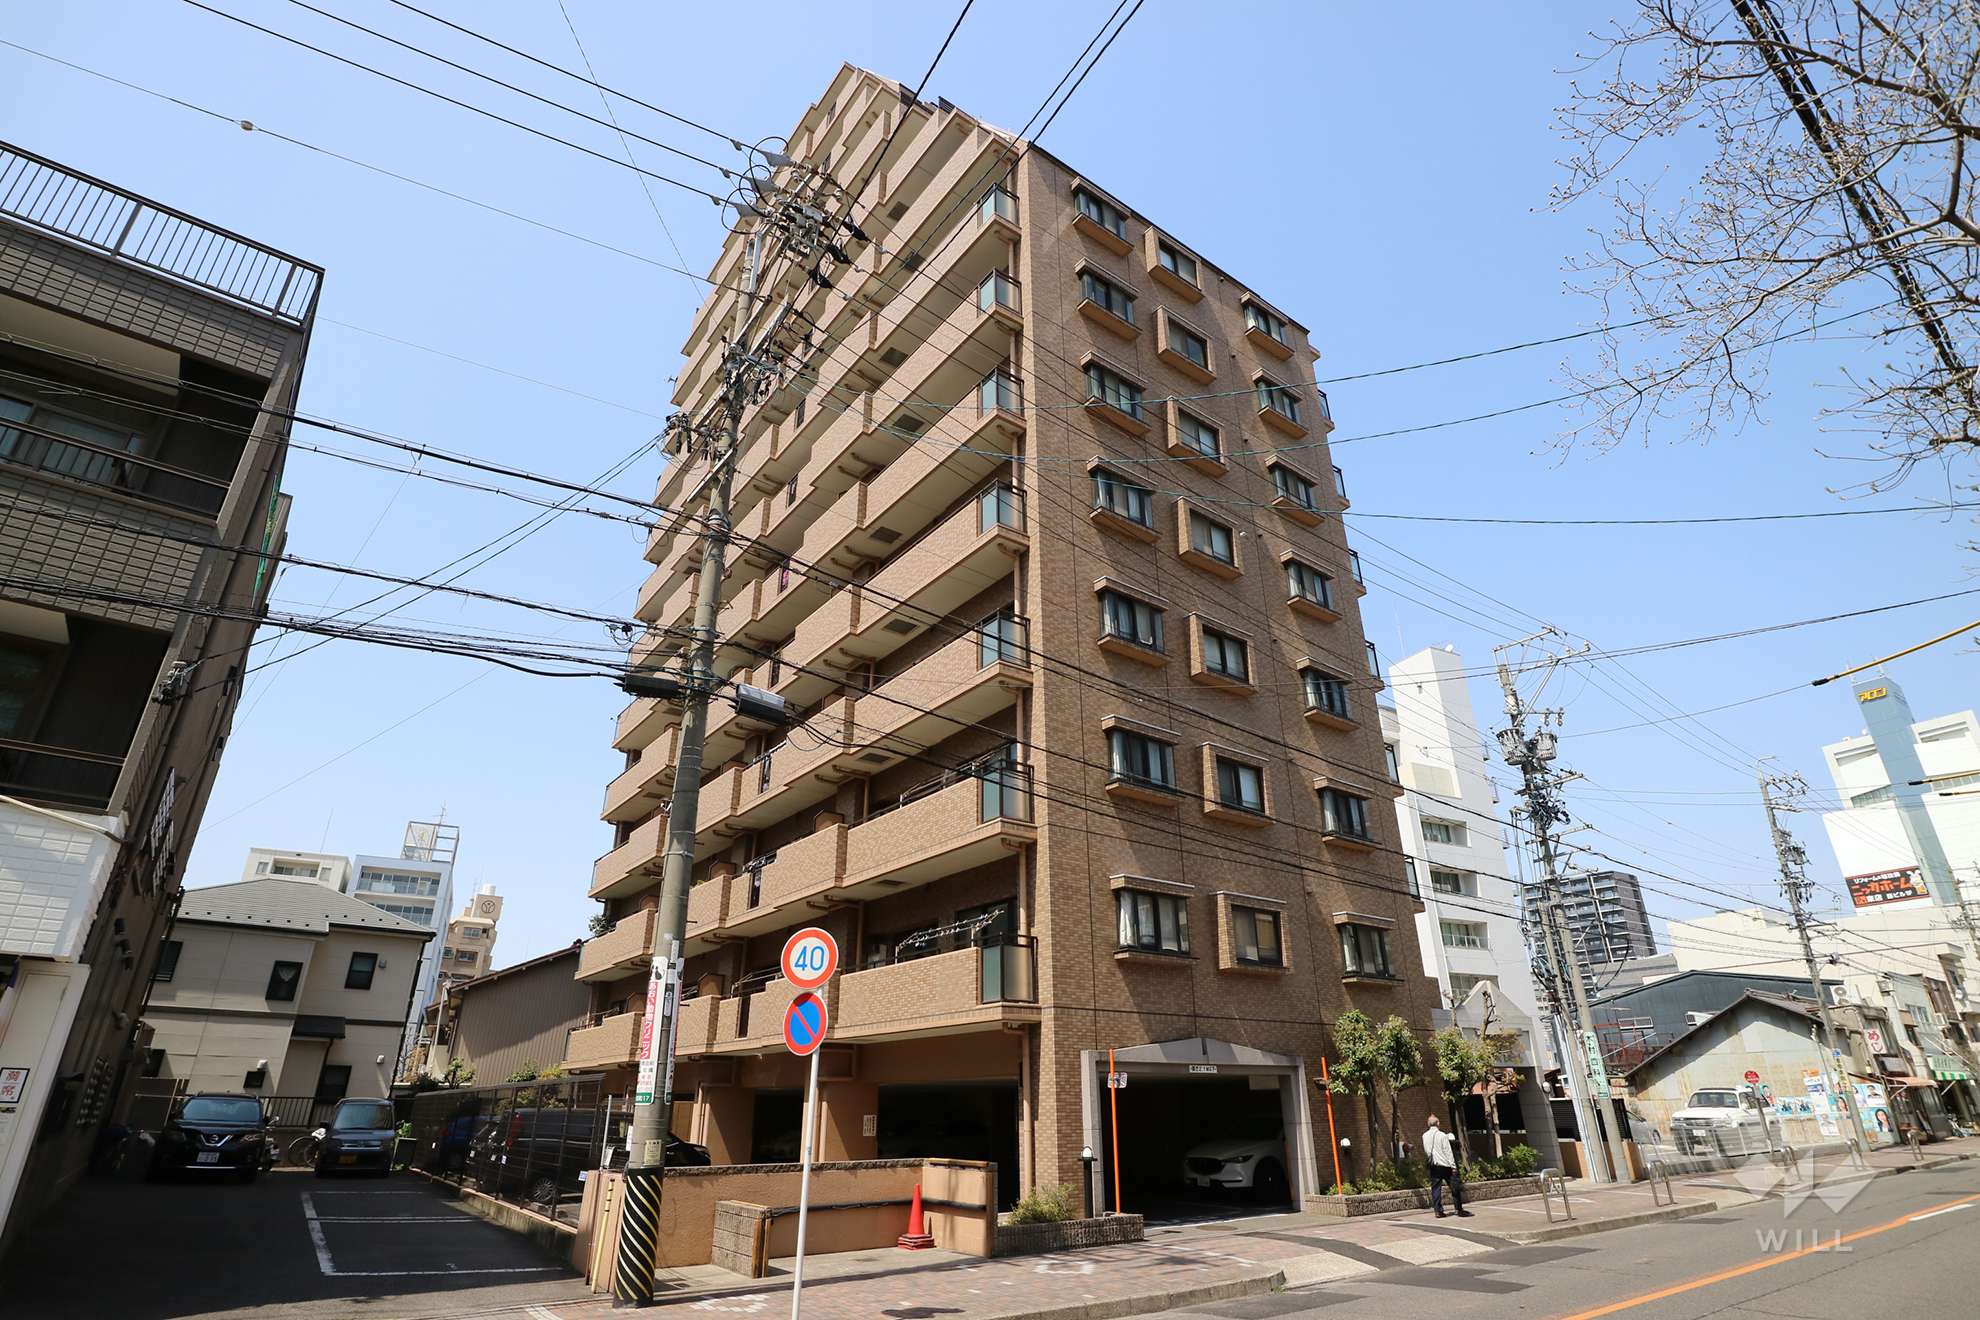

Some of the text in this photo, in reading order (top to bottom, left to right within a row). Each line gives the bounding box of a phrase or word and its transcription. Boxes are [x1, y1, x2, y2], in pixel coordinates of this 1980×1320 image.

[1851, 877, 1912, 896] ニッカホーム
[794, 945, 825, 971] 40
[1867, 1031, 1884, 1052] めし
